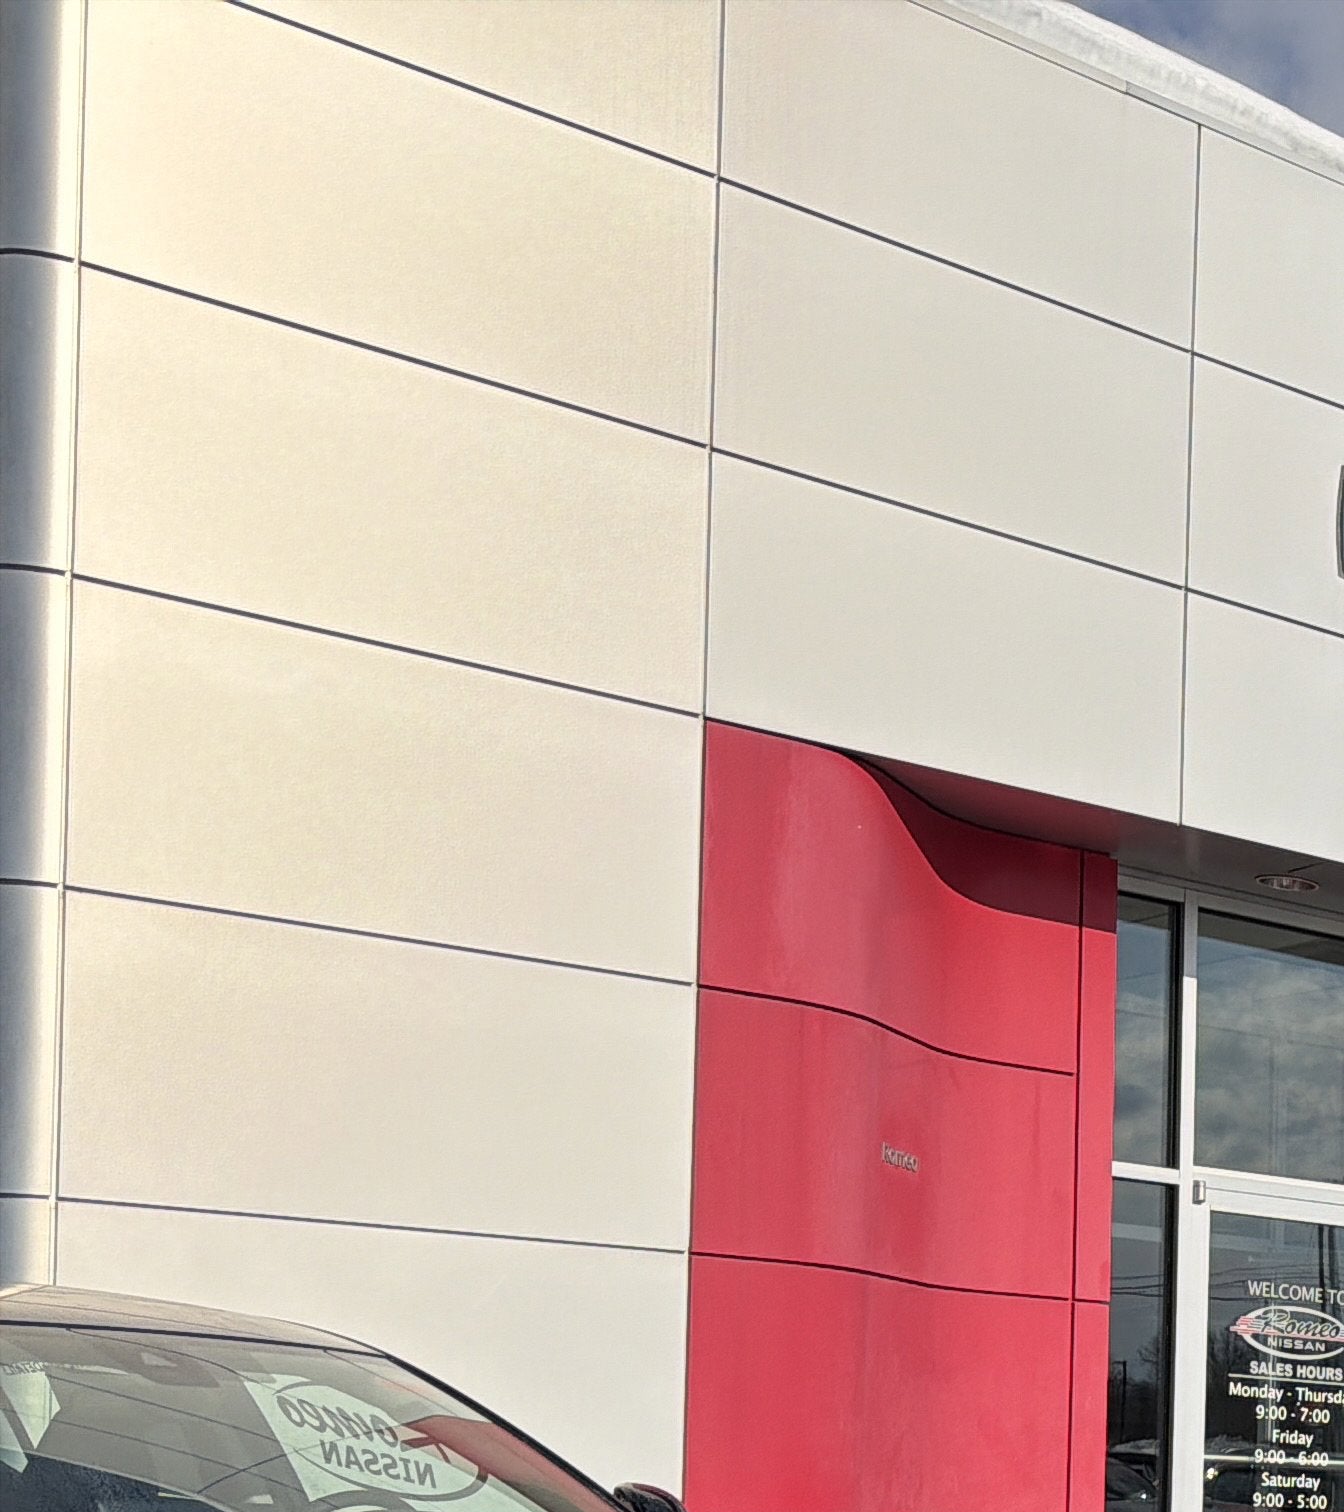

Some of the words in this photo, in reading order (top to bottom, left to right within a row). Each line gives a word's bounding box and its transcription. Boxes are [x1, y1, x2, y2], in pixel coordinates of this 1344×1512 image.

[1248, 1280, 1324, 1303] WELCOME
[1255, 1308, 1341, 1338] Romeo
[1267, 1337, 1326, 1351] NISSAN
[1250, 1361, 1293, 1376] SALES
[1296, 1365, 1343, 1380] HOURS
[1228, 1382, 1284, 1402] Monday
[1255, 1405, 1287, 1420] 9:00
[1300, 1407, 1331, 1423] 7:00
[1272, 1429, 1314, 1448] Friday
[1255, 1449, 1285, 1464] 9:00
[1298, 1451, 1329, 1467] 6:00
[1261, 1472, 1320, 1491] Saturday
[1252, 1493, 1284, 1508] 9:00
[1297, 1495, 1328, 1510] 5:00
